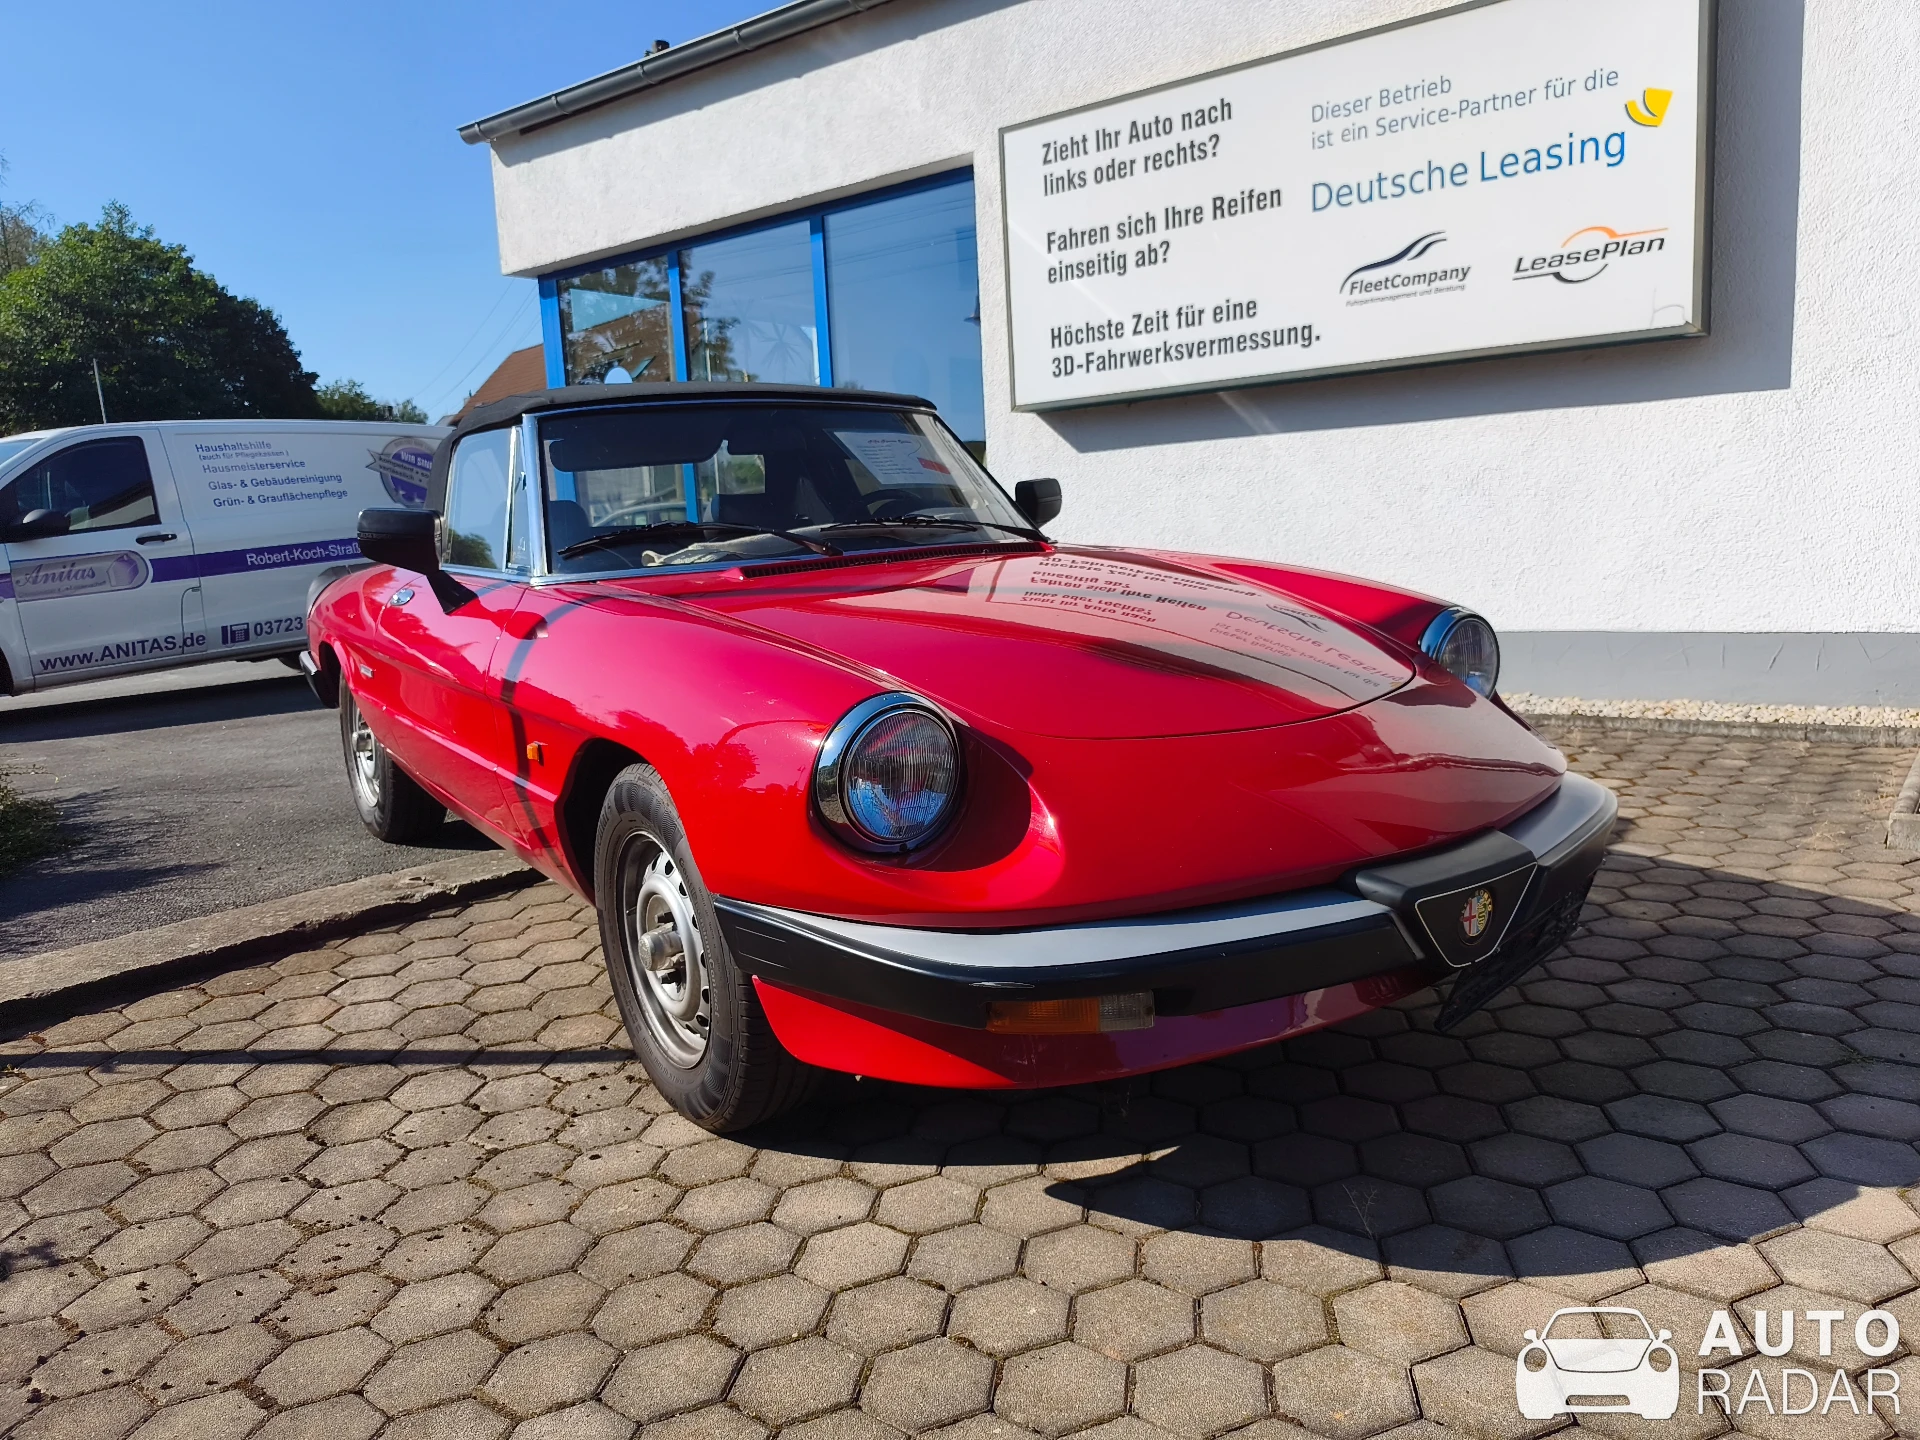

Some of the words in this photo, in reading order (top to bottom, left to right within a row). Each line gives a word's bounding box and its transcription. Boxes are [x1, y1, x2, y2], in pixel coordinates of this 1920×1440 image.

[1312, 94, 1371, 123] Dieser
[1379, 75, 1452, 107] Betrieb
[1312, 130, 1333, 149] ist
[1341, 124, 1368, 143] ein
[1376, 89, 1536, 136] Service-Partner
[1544, 76, 1576, 103] für
[1584, 68, 1619, 91] die
[1042, 134, 1092, 168] Zieht
[1096, 128, 1121, 153] Ihr
[1128, 115, 1173, 145] Auto
[1181, 98, 1232, 131] nach
[1043, 168, 1087, 196] links
[1094, 158, 1135, 185] oder
[1143, 133, 1220, 173] rechts?
[1312, 160, 1468, 213] Deutsche
[1481, 130, 1626, 181] Leasing
[1047, 223, 1109, 254] Fahren
[1117, 211, 1157, 240] sich
[1165, 204, 1204, 229] Ihre
[1212, 188, 1282, 220] Reifen
[1048, 250, 1127, 284] einseitig
[1135, 240, 1170, 267] ab?
[1514, 236, 1665, 274] LeasePlan
[1349, 265, 1471, 296] FleetCompany
[1050, 317, 1125, 349] Höchste
[1132, 310, 1169, 336] Zeit
[1176, 306, 1204, 329] für
[1212, 299, 1257, 323] eine
[1052, 324, 1321, 378] 3D-Fahrwerksvermessung.
[195, 440, 272, 453] Haushaltshilfe
[202, 459, 306, 473] Hausmeisterservice
[208, 480, 238, 491] Glas-
[240, 479, 249, 489] &
[251, 474, 343, 488] Gebäudereinigung
[213, 497, 245, 508] Grün-
[247, 495, 256, 505] &
[258, 489, 349, 504] Grauflächenpflege
[15, 562, 97, 586] Anitas
[253, 617, 304, 637] 03723
[40, 632, 207, 671] www.ANITAS.de
